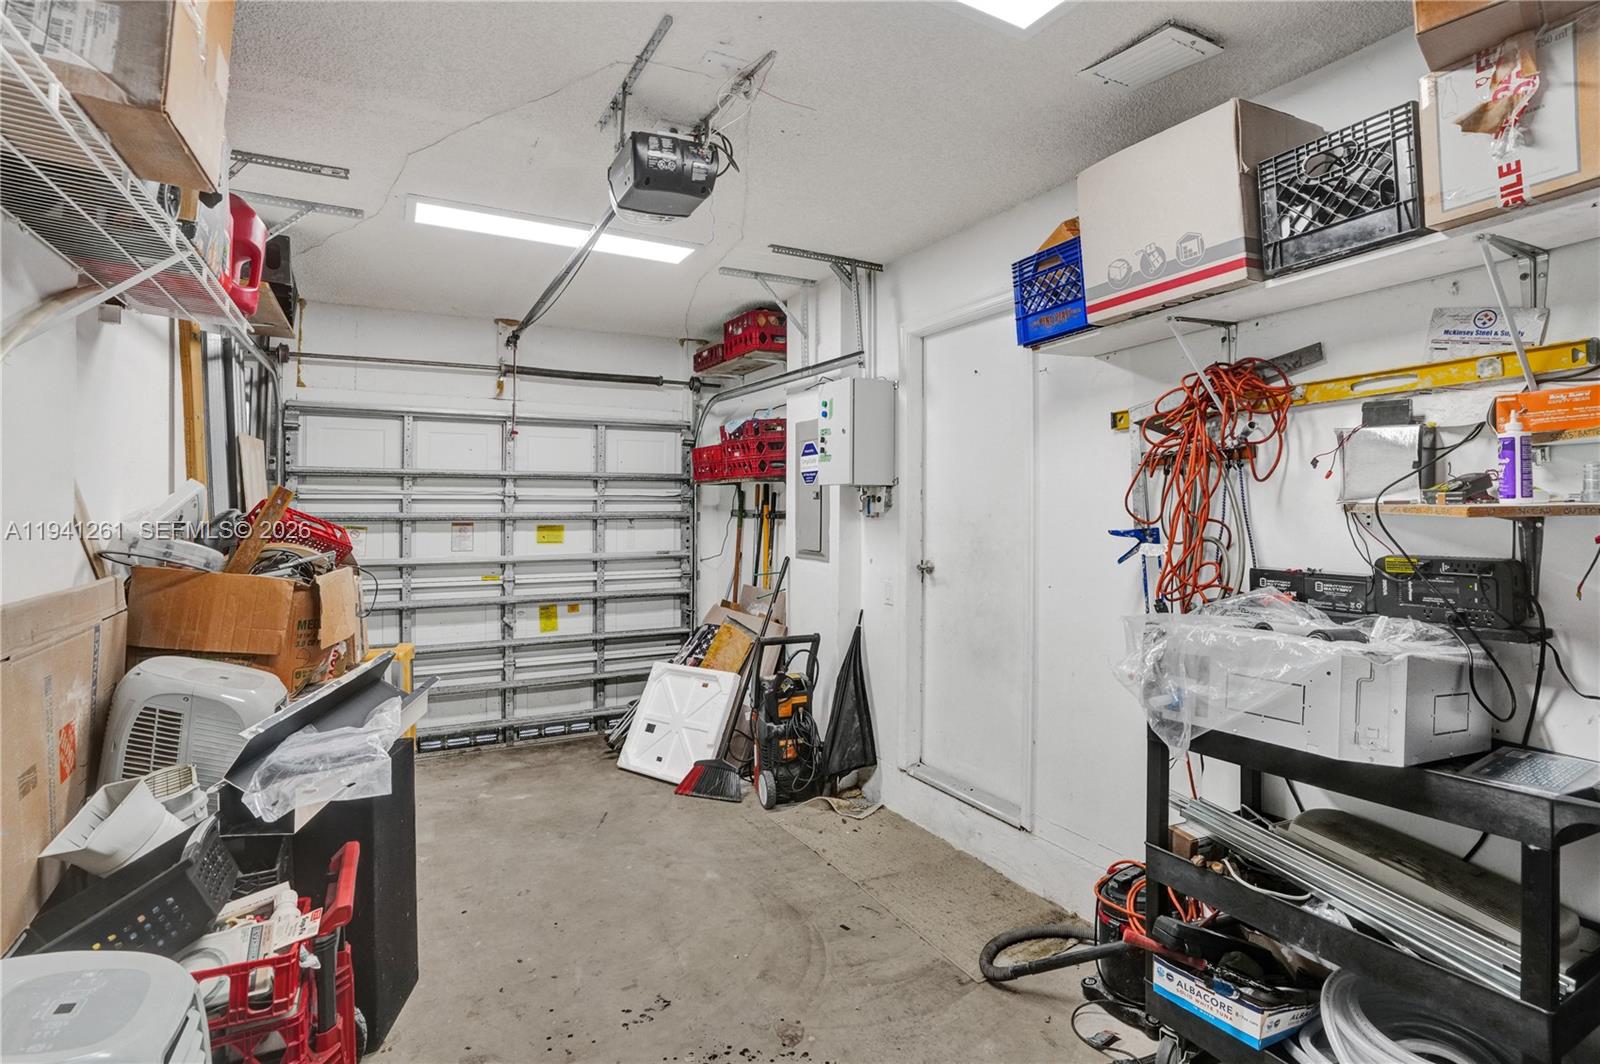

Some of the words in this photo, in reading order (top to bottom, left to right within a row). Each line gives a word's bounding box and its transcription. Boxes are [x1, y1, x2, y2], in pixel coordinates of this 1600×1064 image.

[1176, 980, 1233, 1015] ALBACORE
[1194, 999, 1214, 1012] WHITE
[1216, 1009, 1233, 1021] TUNA
